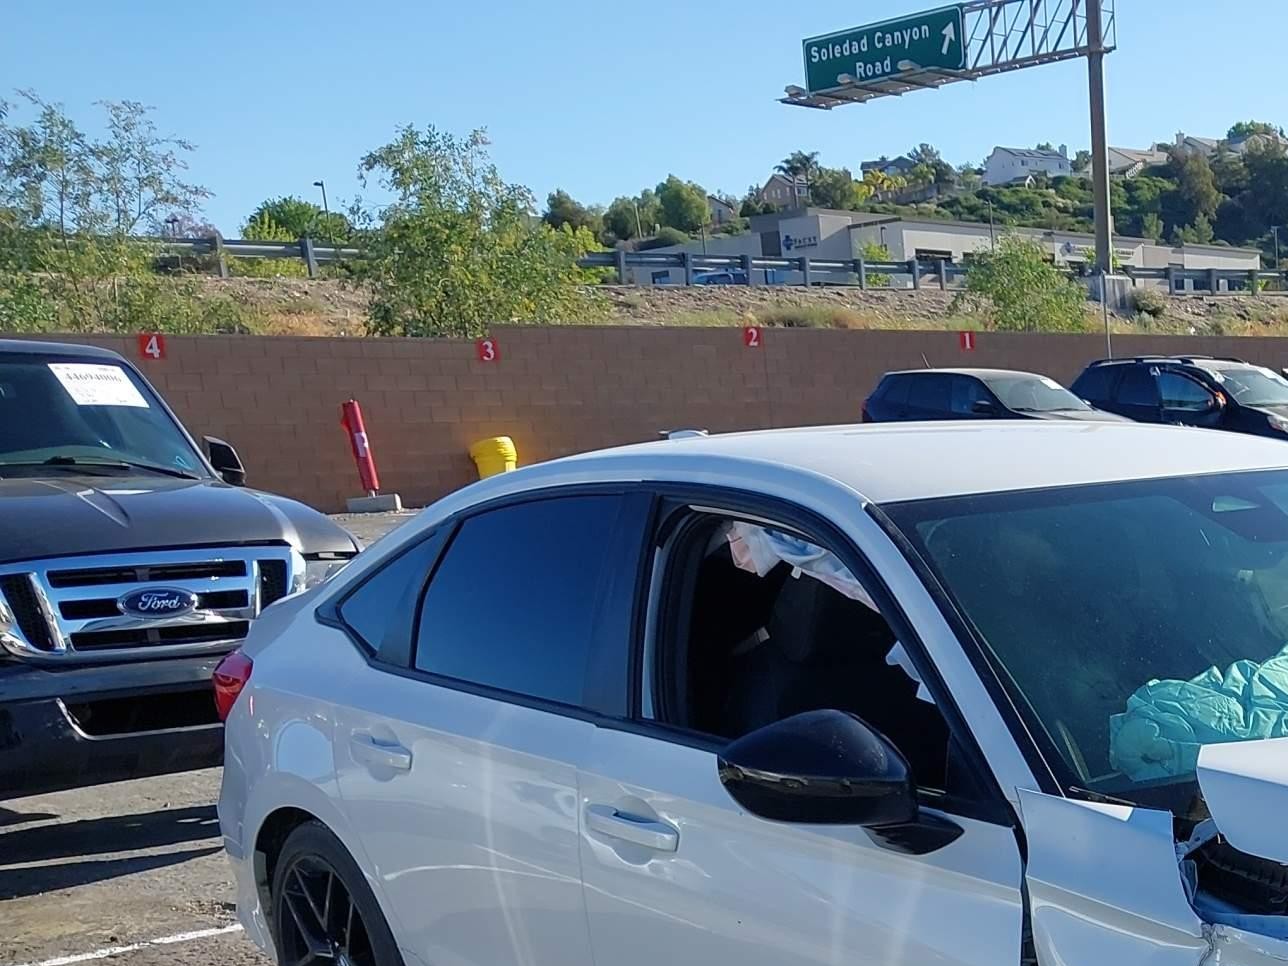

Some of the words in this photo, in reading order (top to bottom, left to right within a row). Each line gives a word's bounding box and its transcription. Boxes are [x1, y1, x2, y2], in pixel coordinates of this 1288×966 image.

[811, 35, 868, 62] Soledad
[875, 25, 930, 49] Canyon
[856, 56, 892, 78] Road
[145, 335, 161, 358] 4
[748, 328, 759, 346] 2
[482, 341, 495, 361] 3
[138, 592, 181, 611] Ford
